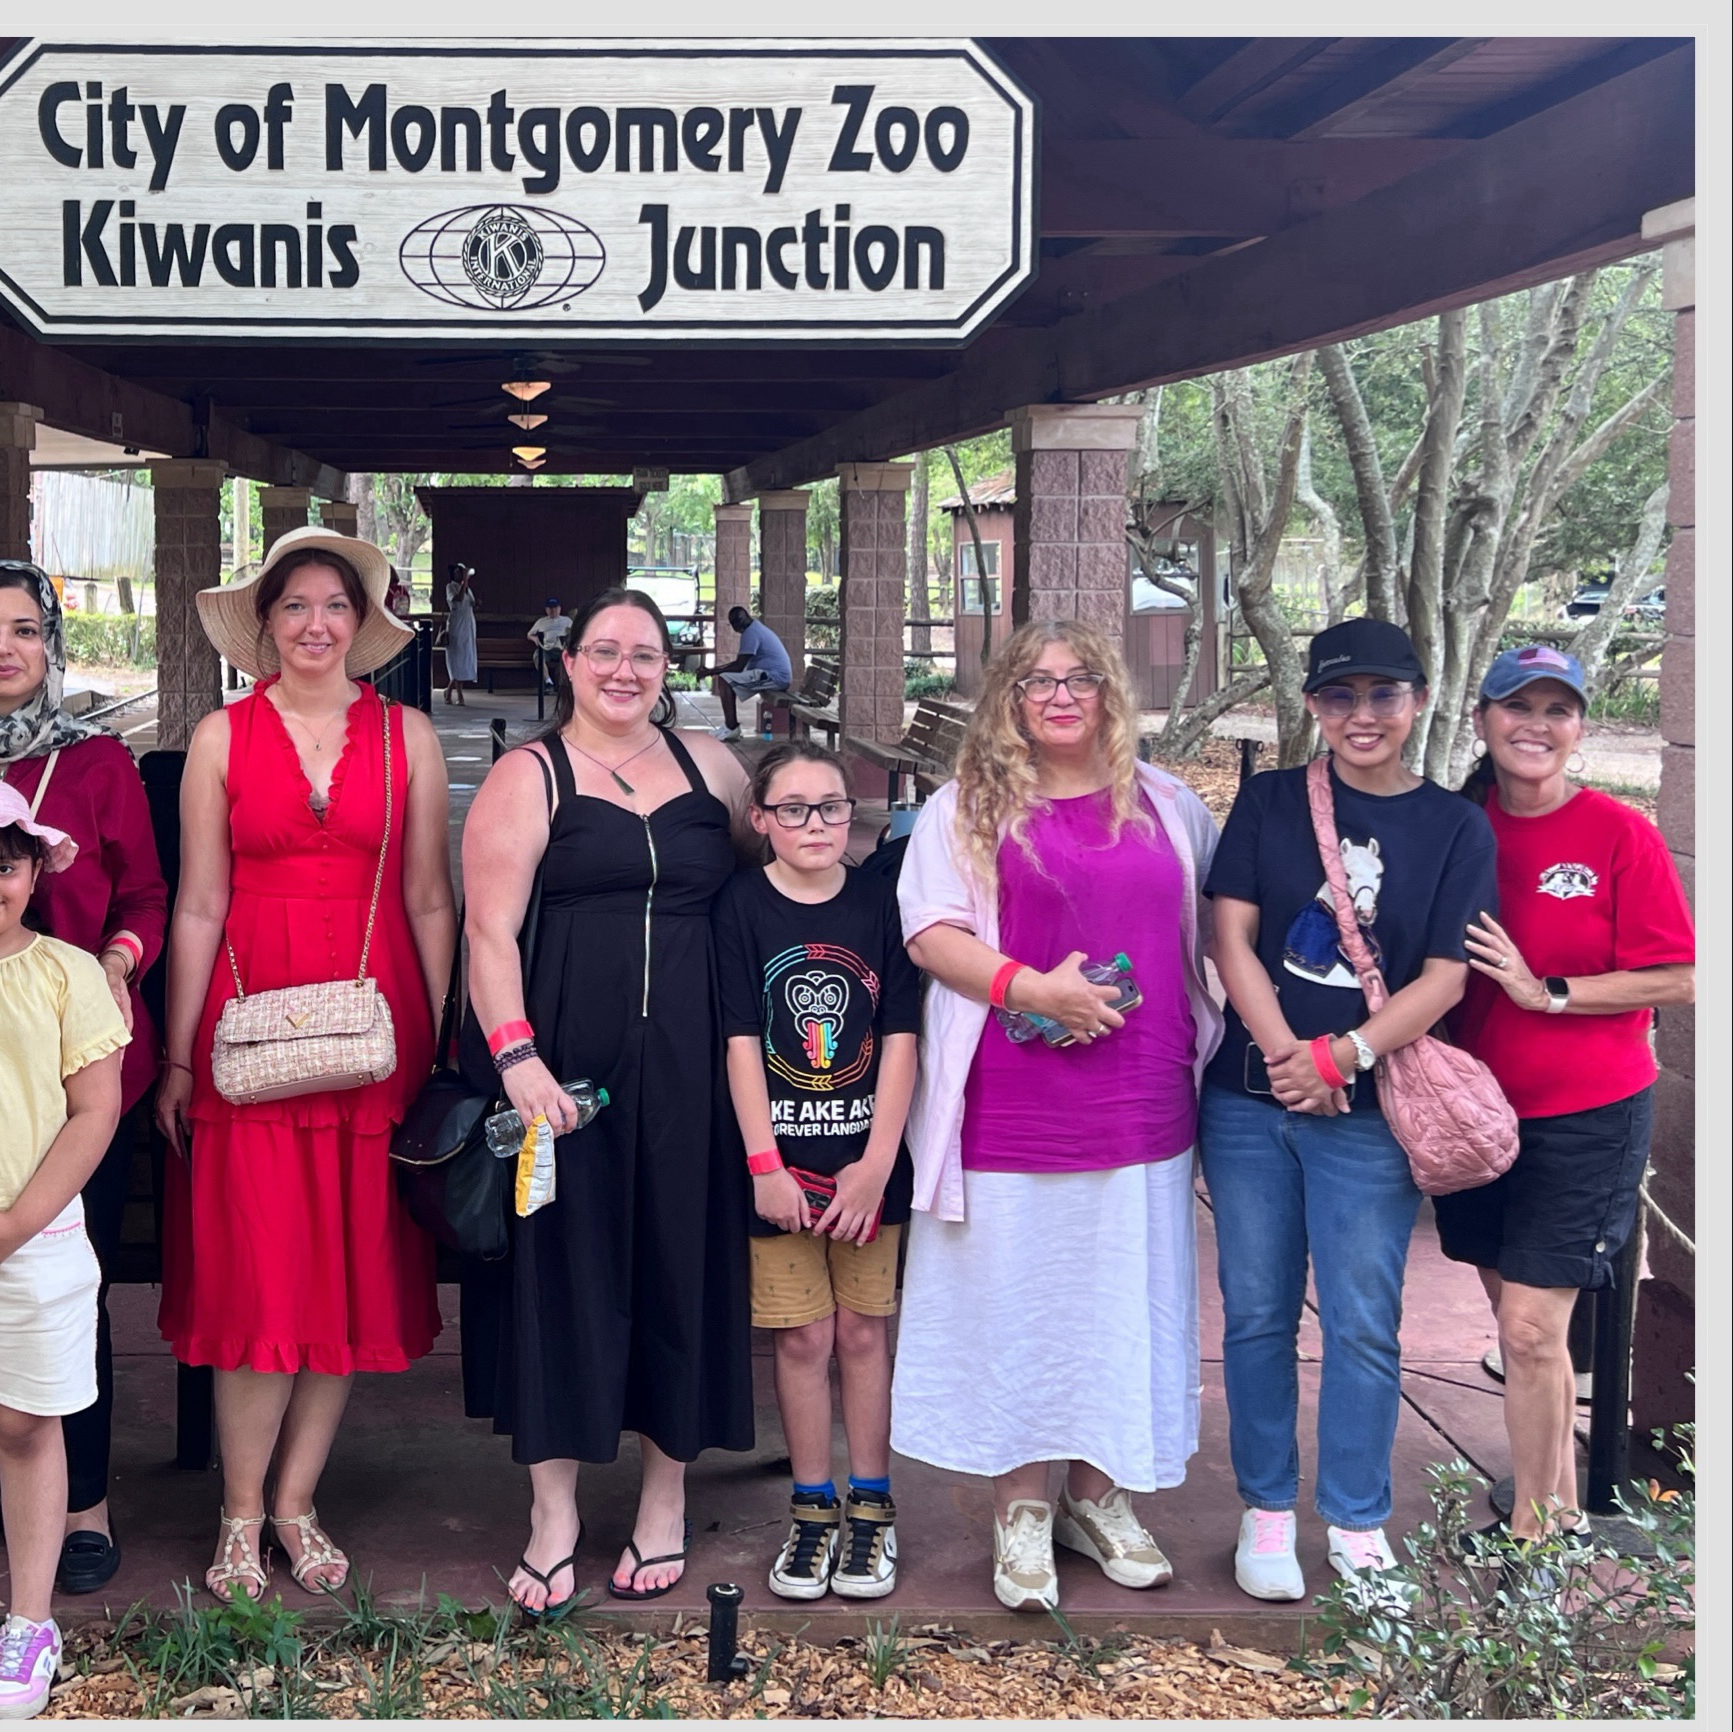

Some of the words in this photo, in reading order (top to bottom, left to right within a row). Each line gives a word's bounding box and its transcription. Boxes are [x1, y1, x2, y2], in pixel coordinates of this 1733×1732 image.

[38, 81, 188, 193] City
[213, 83, 293, 172] of
[325, 83, 797, 196] Montgomery
[828, 84, 970, 173] Zoo
[477, 223, 529, 242] KIWANIS
[63, 200, 360, 291] Kiwanis
[637, 203, 946, 315] Junction
[469, 255, 537, 292] INTERNATIONAL
[771, 1100, 795, 1121] KE
[799, 1100, 845, 1122] AKE
[773, 1123, 821, 1137] OREVER
